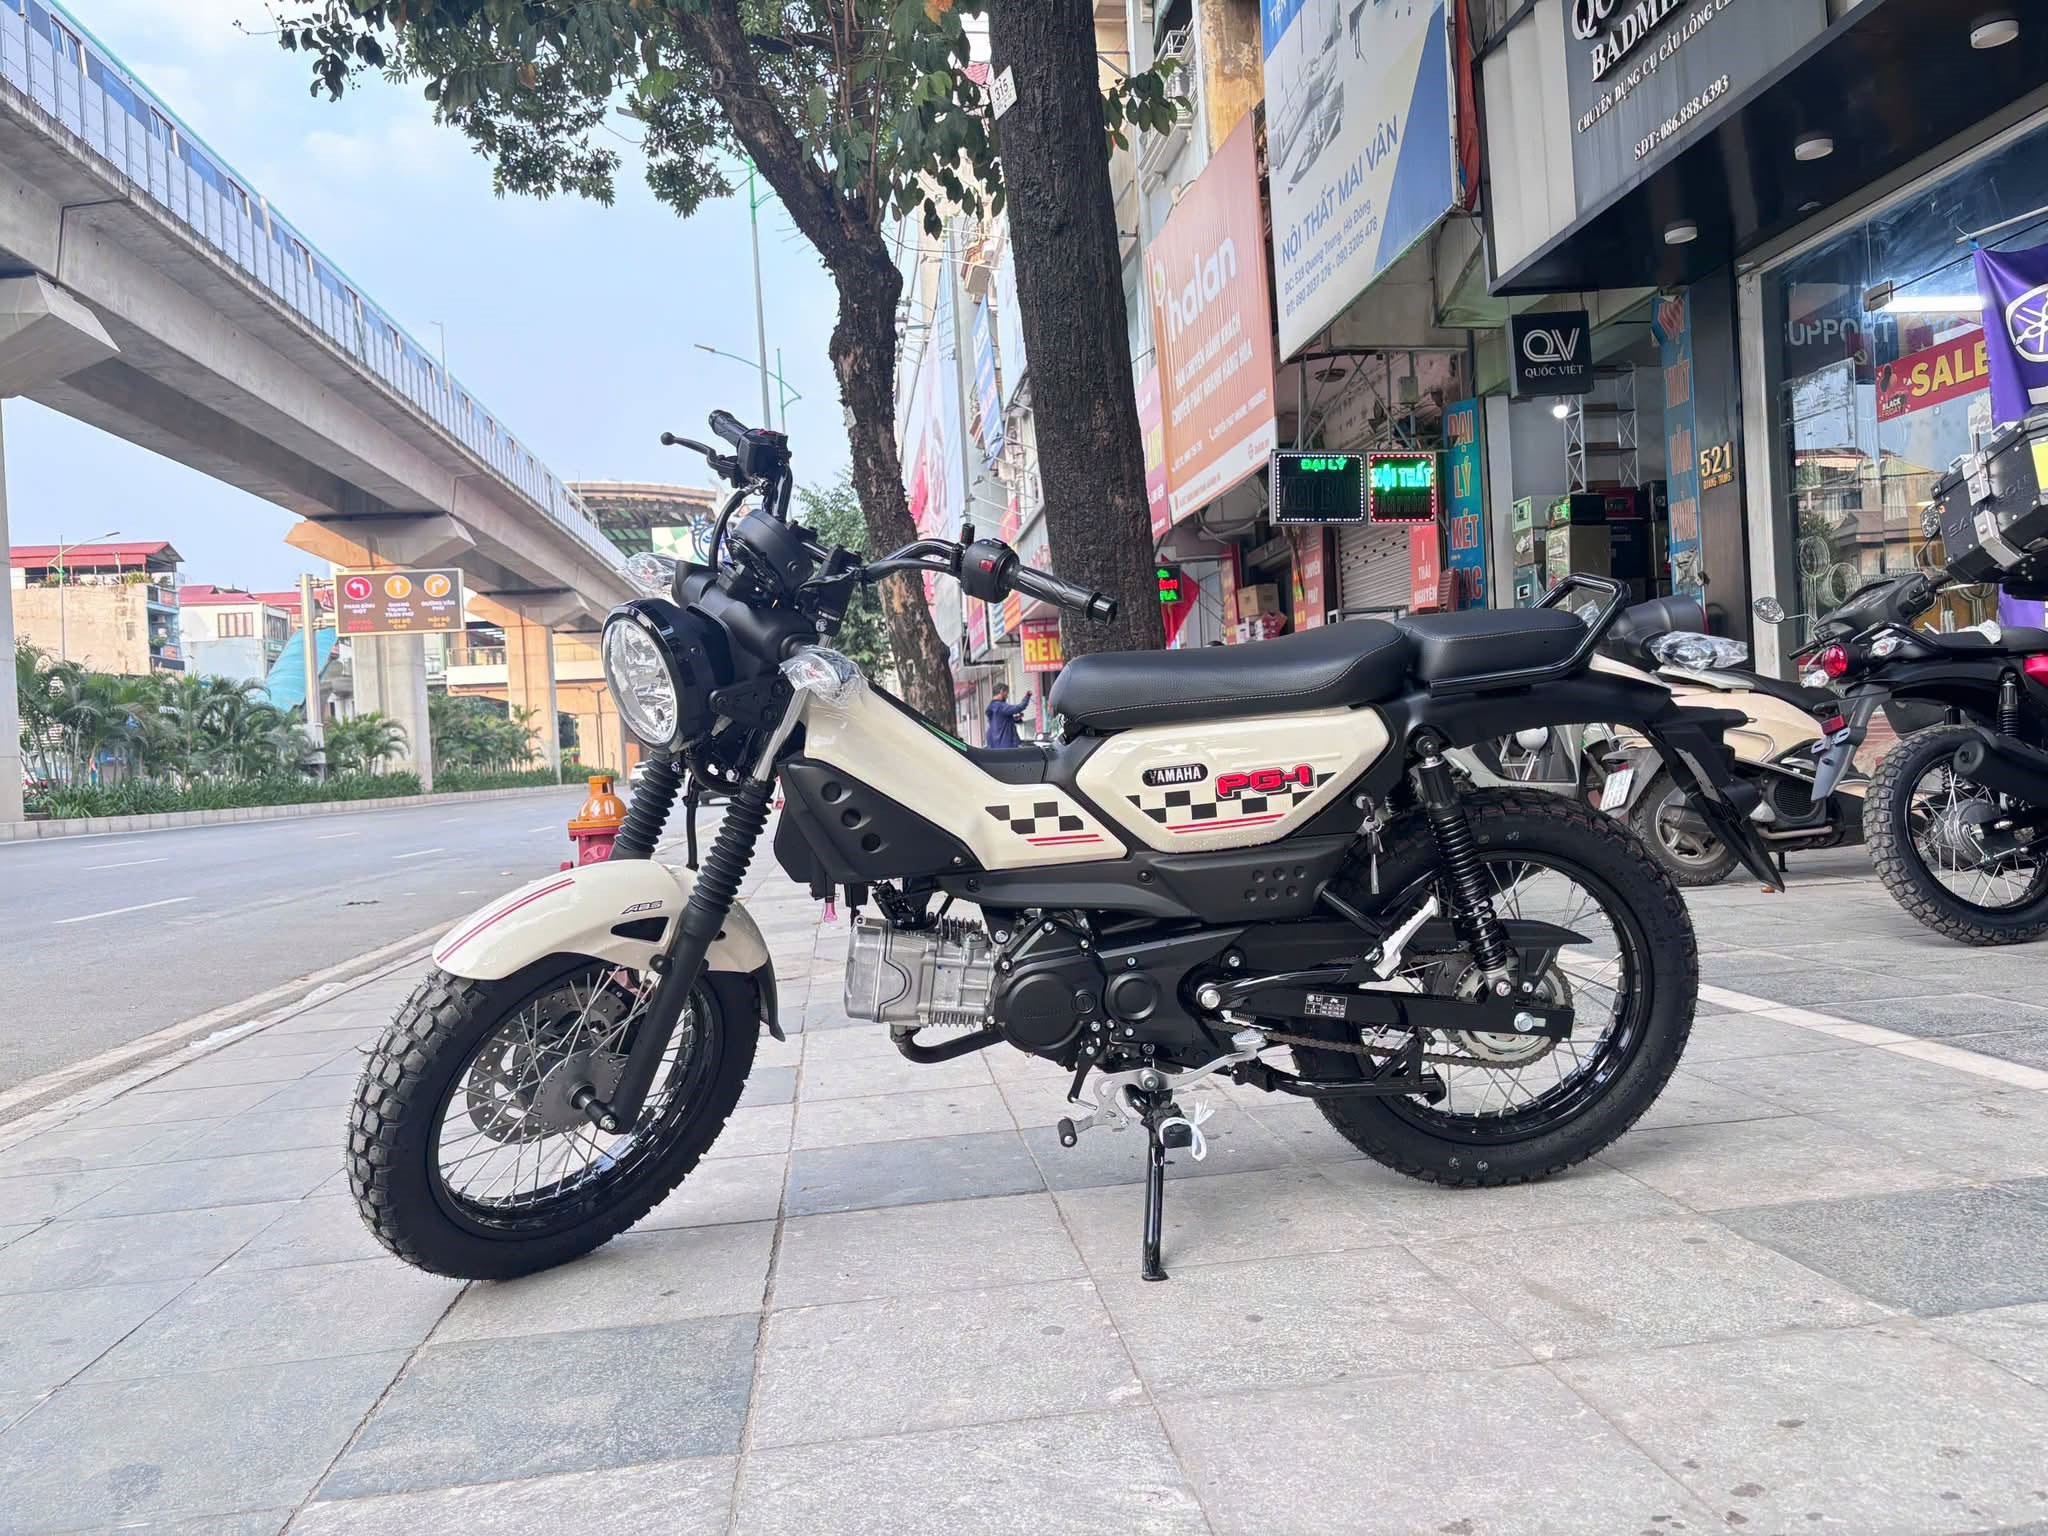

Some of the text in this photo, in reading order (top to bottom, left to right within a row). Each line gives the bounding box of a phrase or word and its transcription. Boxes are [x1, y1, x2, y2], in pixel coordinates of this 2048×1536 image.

[1577, 93, 1612, 133] CHUYÊN
[1614, 68, 1641, 100] DỤNG
[1642, 55, 1658, 74] CỤ
[1659, 31, 1681, 61] CẦU
[1682, 5, 1713, 41] LÔNG
[1281, 115, 1398, 268] NỘI THẤT MAI VÂN
[1523, 327, 1580, 362] QV
[1525, 363, 1584, 378] QUỐC VIỆT
[1911, 339, 1990, 397] SALE
[1301, 456, 1347, 472] ĐẠI LÝ
[1398, 461, 1433, 487] THẤT
[1700, 441, 1733, 477] 521
[1453, 456, 1472, 498] LÝ
[1451, 508, 1479, 550] KÉT
[1150, 766, 1202, 784] YAMAHA
[1216, 763, 1315, 798] PG-1
[620, 900, 663, 915] ABS
